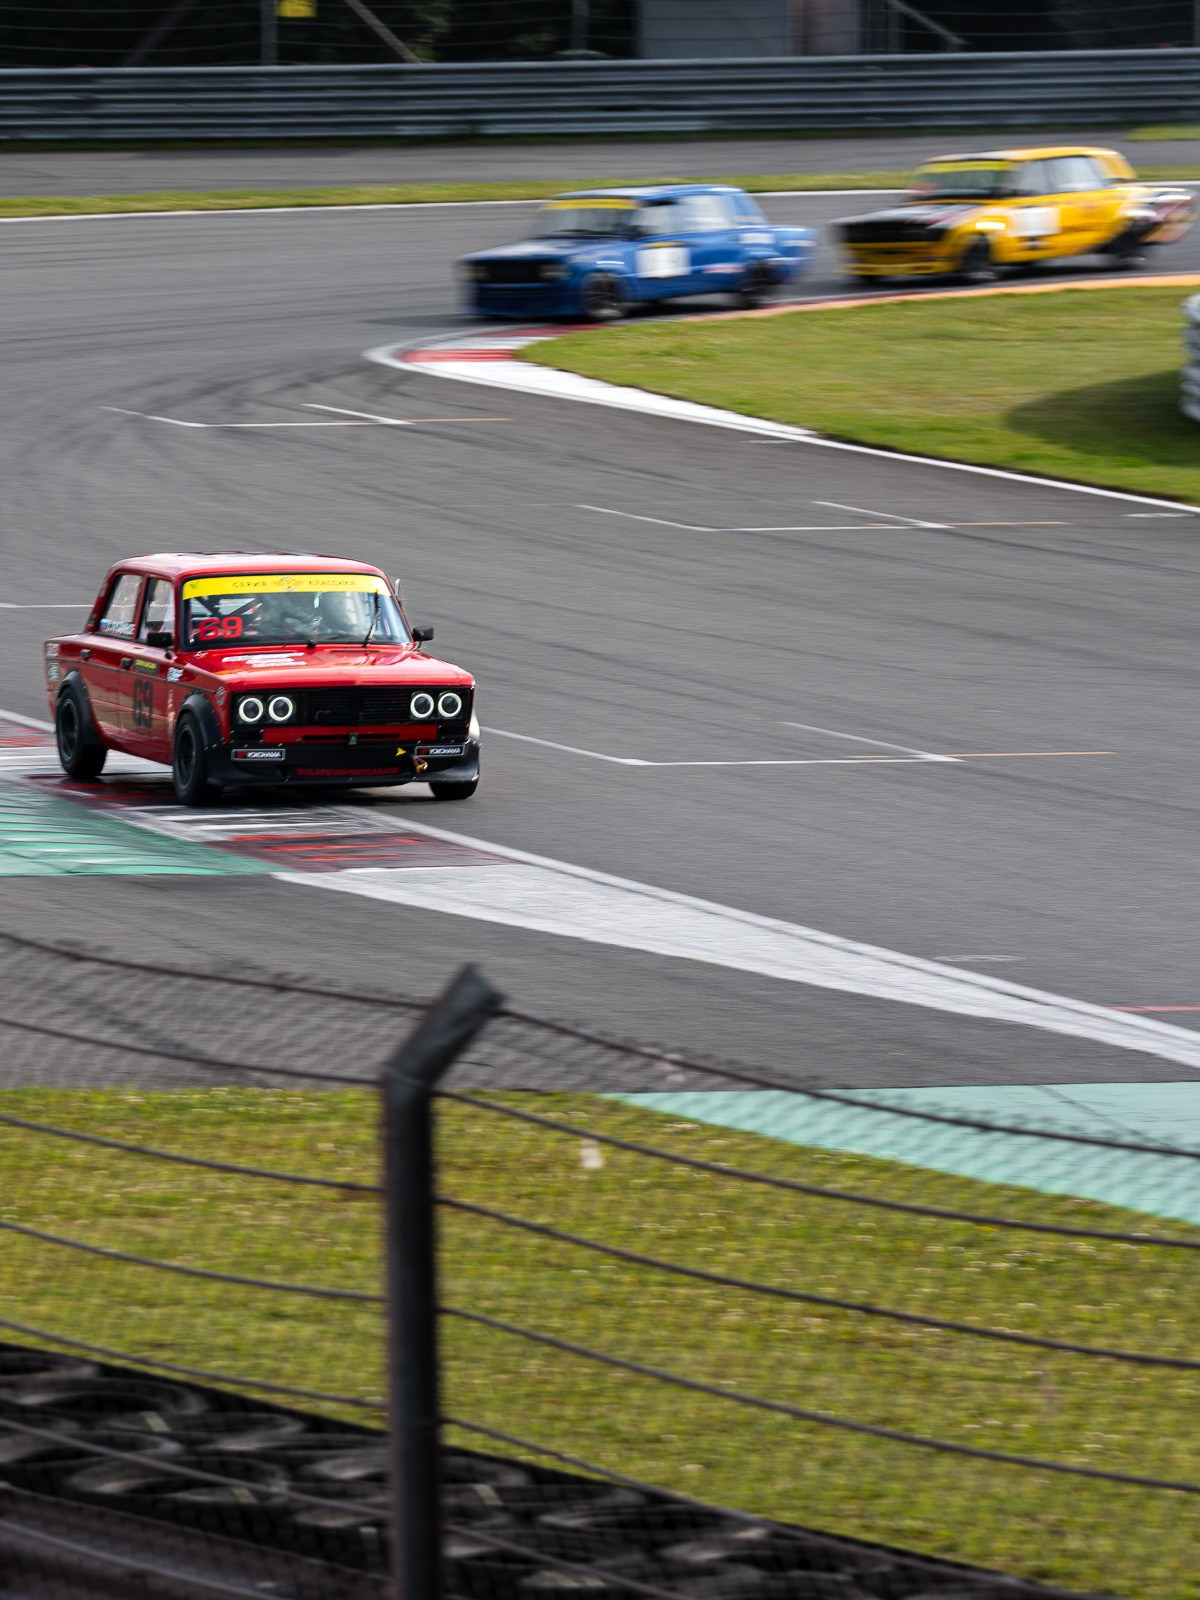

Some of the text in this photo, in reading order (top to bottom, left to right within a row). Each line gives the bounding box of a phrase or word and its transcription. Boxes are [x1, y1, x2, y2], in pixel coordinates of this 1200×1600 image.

[198, 616, 243, 641] 69
[133, 678, 153, 728] 69
[247, 751, 281, 759] YOKOHAMA
[429, 747, 461, 755] YOKOHAMA
